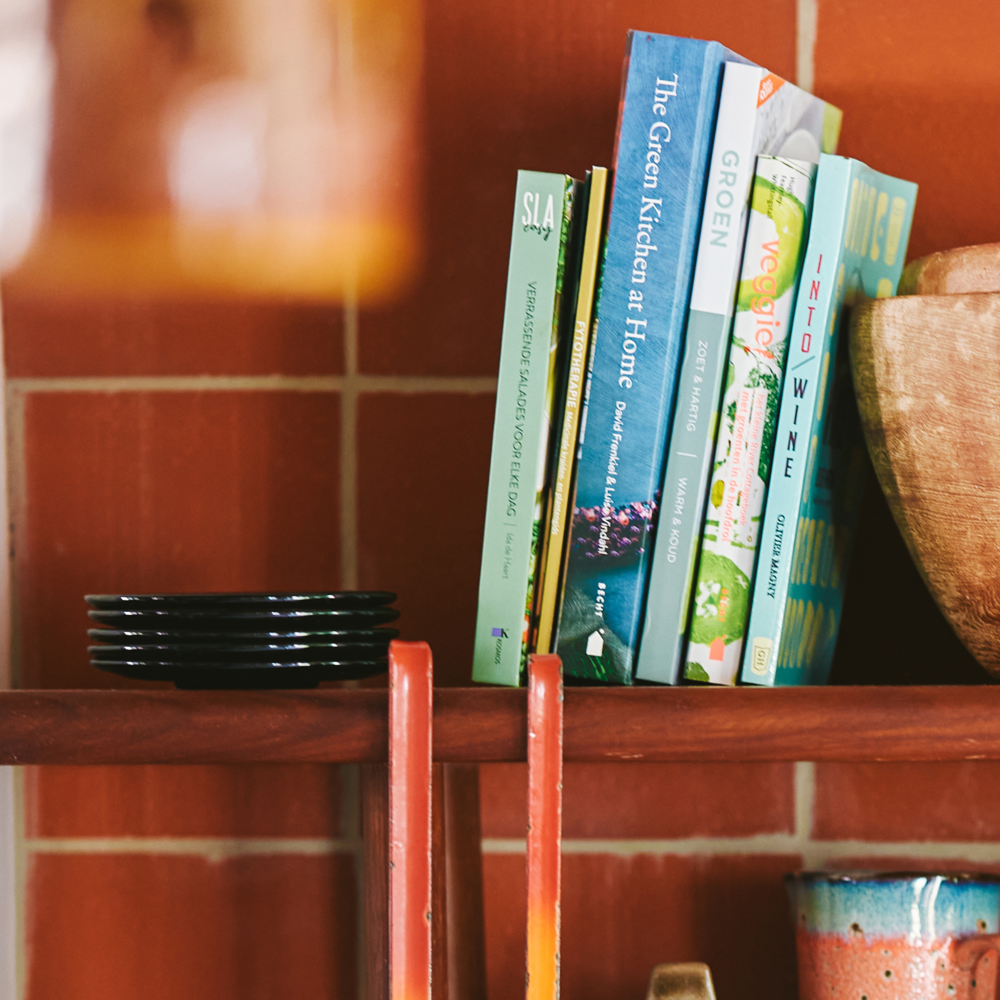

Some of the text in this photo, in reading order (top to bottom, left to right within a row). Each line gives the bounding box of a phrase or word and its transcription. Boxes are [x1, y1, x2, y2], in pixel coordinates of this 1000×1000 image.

[521, 191, 554, 229] SLA
[709, 150, 740, 248] GROEN
[619, 73, 679, 389] The Green Kitchen at Home
[566, 320, 586, 409] FYTOTHERAPIE
[784, 253, 823, 479] INTO WINE
[505, 281, 538, 517] VERRASSENDE SALADES VOOR ELKE DAG
[613, 400, 627, 431] David
[562, 411, 574, 450] Medicinale
[607, 433, 622, 475] Frenkiel
[667, 340, 709, 564] ZOET & HARTIG WARM & KOUD
[721, 391, 750, 542] met groenten in de hoofdrol
[557, 482, 563, 491] en
[606, 476, 617, 486] &
[551, 492, 563, 535] plantengids
[597, 516, 612, 556] Vindahl
[767, 514, 786, 599] OLIVIER MAGNY
[595, 582, 607, 618] BECHT
[756, 649, 767, 667] GH
